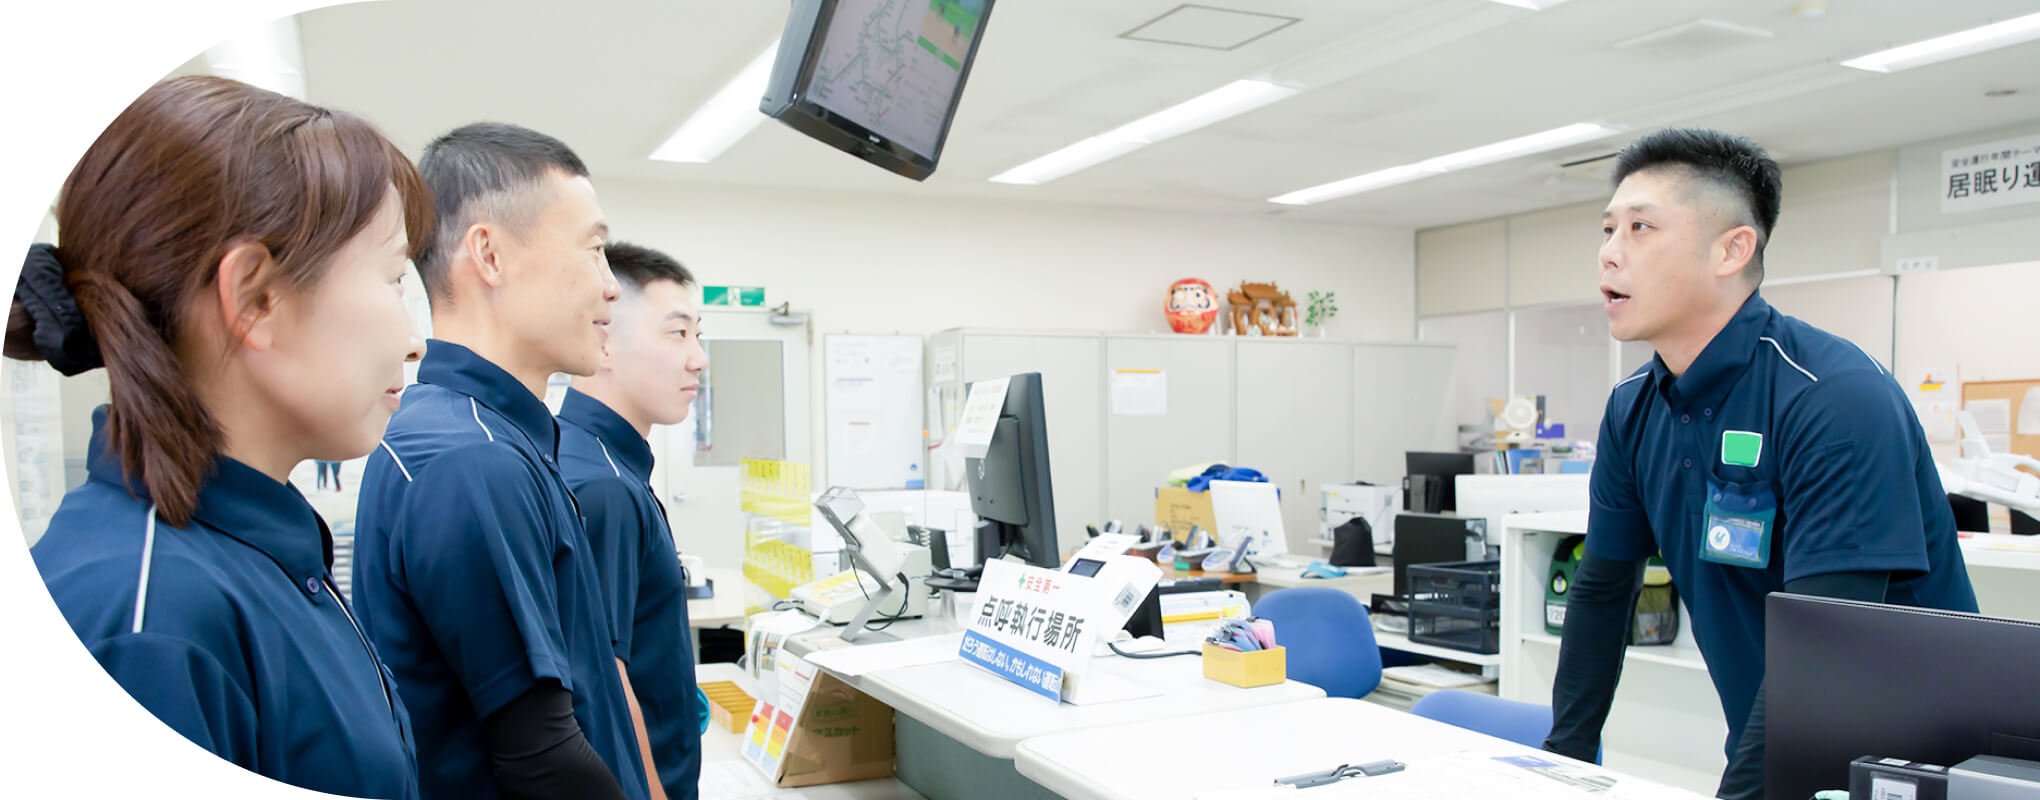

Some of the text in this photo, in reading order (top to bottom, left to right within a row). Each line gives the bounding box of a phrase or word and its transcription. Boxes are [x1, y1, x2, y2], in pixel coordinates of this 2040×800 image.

[1025, 575, 1060, 594] 安全第一
[977, 594, 1085, 654] 点呼執行場所
